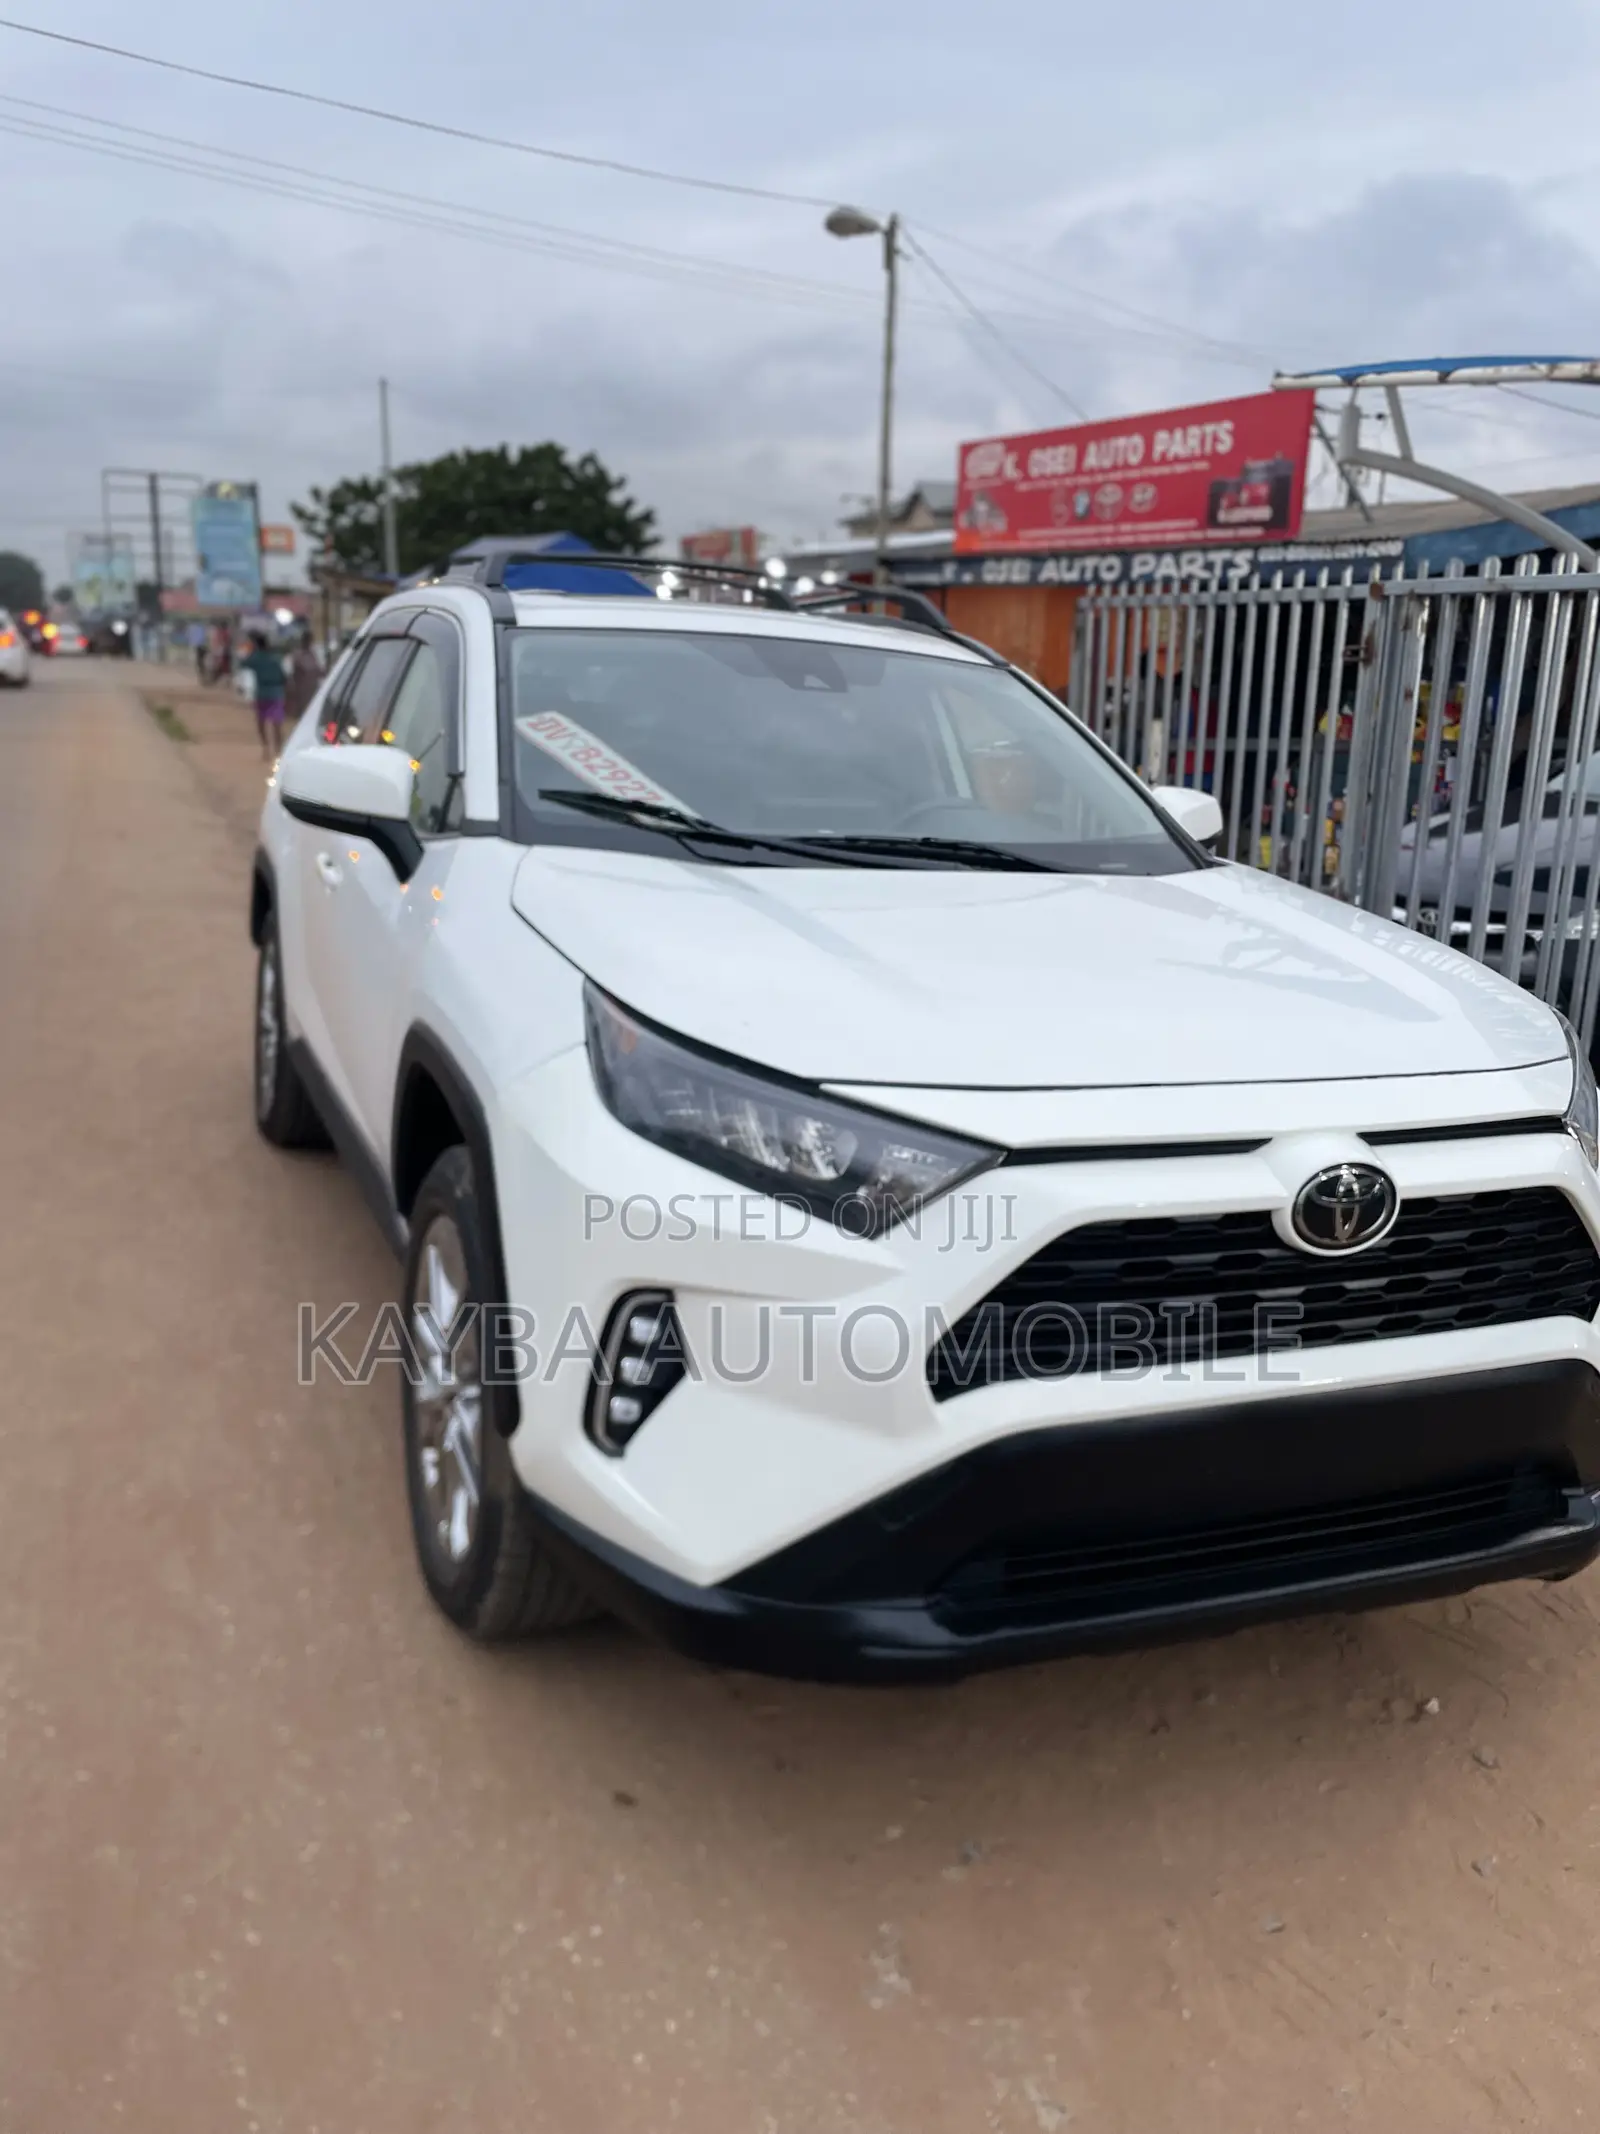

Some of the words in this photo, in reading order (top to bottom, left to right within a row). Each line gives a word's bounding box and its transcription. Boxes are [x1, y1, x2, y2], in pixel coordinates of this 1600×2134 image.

[1082, 433, 1146, 471] AUTO
[1152, 421, 1234, 462] PARTS
[1037, 554, 1121, 583] AUTO
[1130, 548, 1254, 581] PARTS
